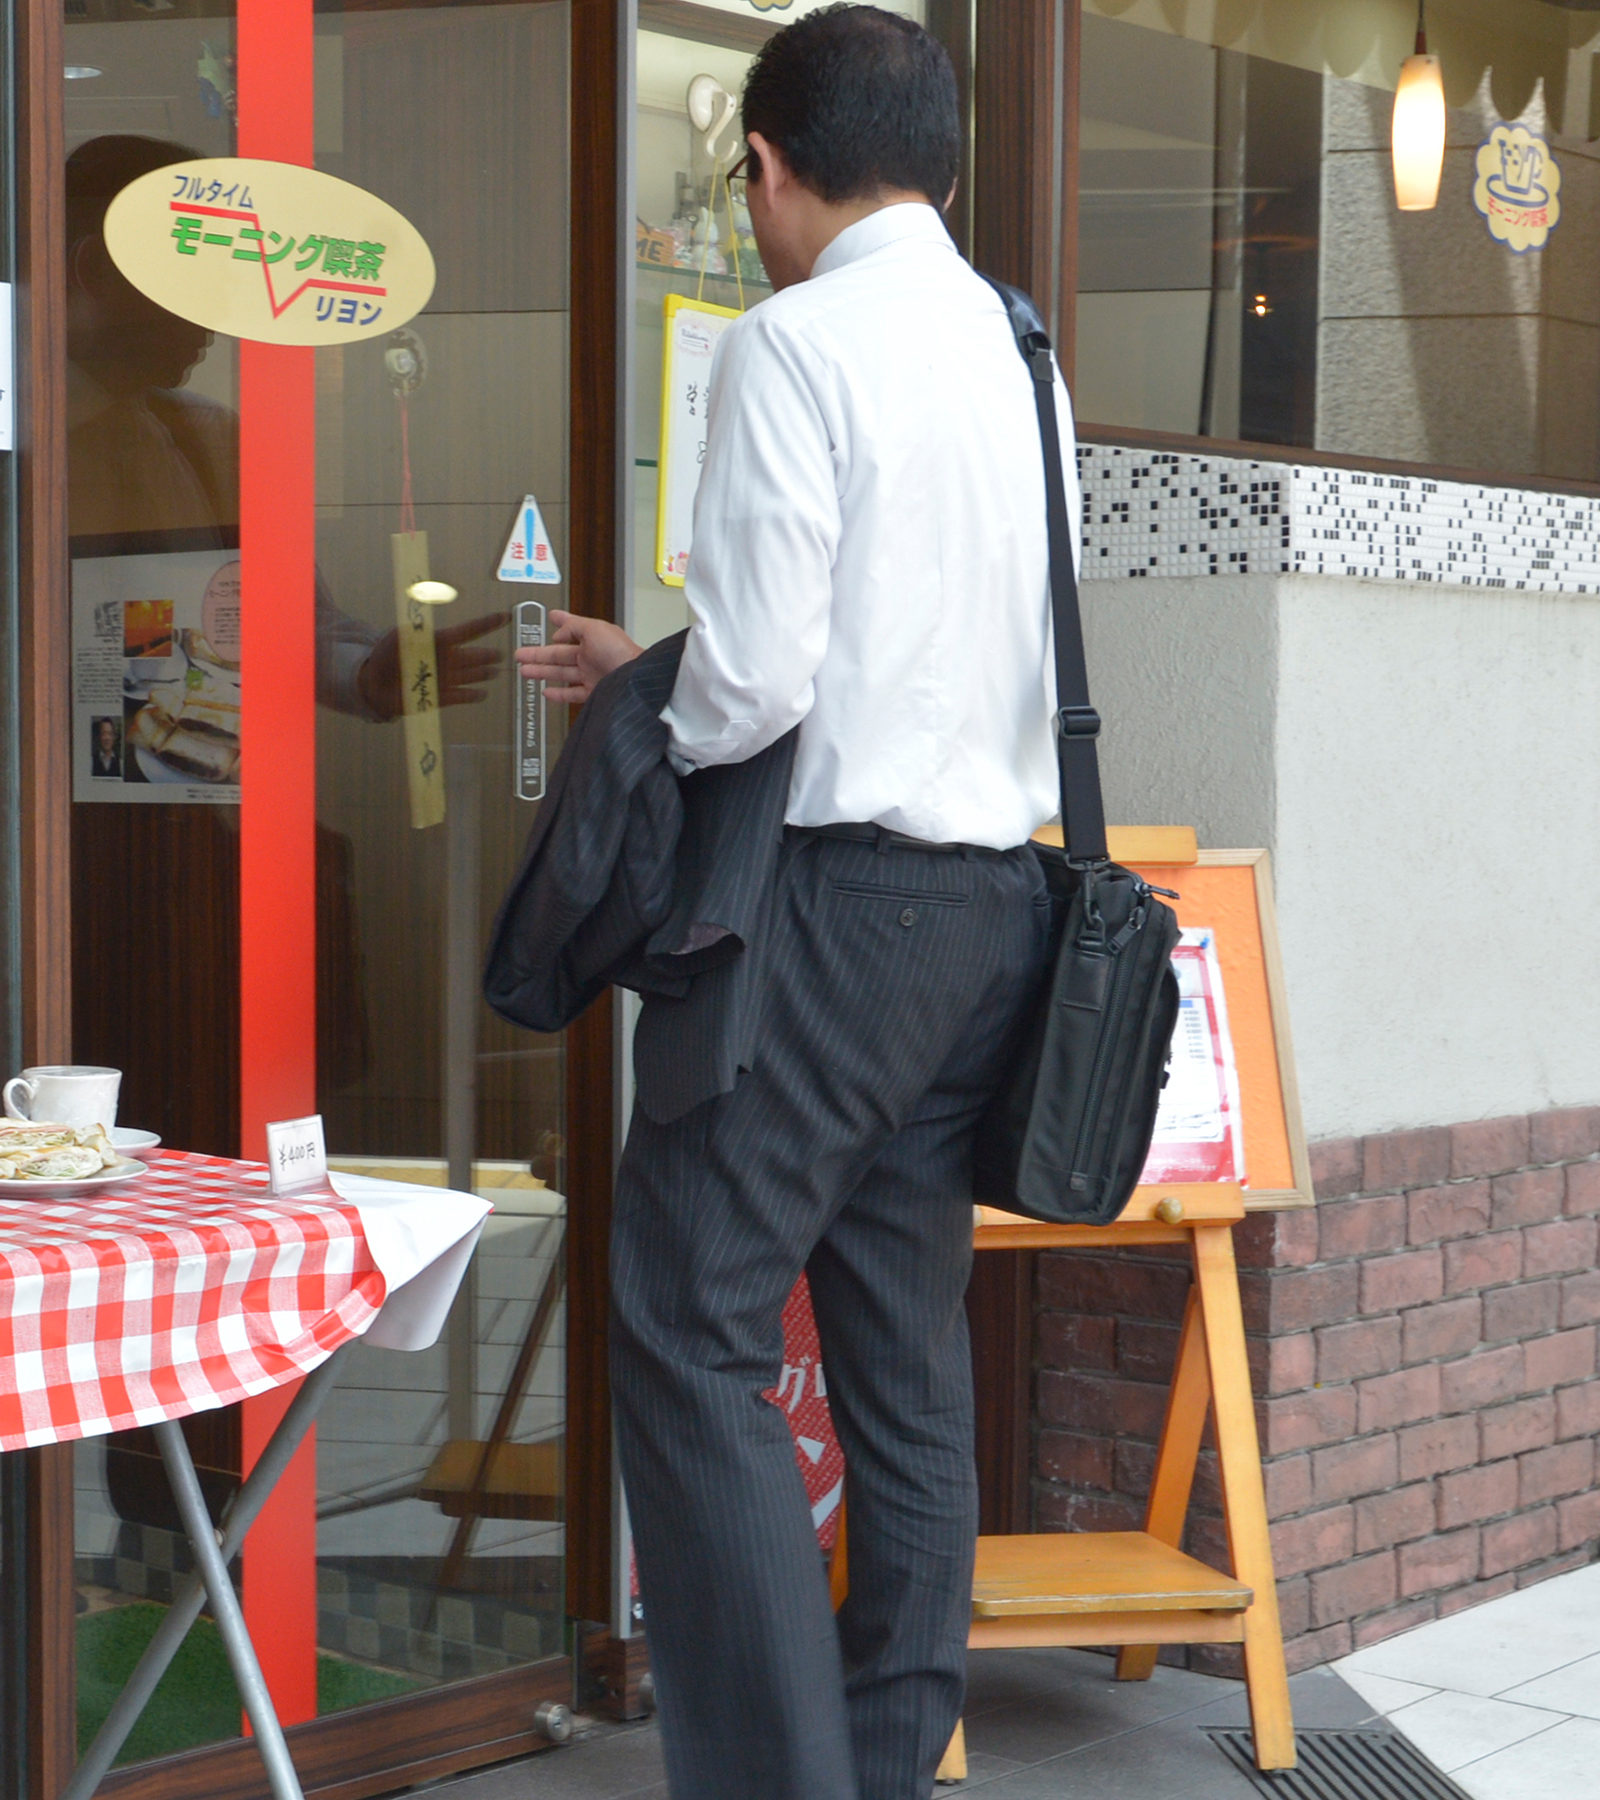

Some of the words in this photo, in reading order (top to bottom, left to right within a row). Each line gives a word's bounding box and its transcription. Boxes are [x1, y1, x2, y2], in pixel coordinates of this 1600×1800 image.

[172, 174, 254, 209] フルタイム
[170, 216, 387, 281] モーニング喫茶
[315, 295, 383, 326] リヨン
[278, 1141, 316, 1172] ¥400円
